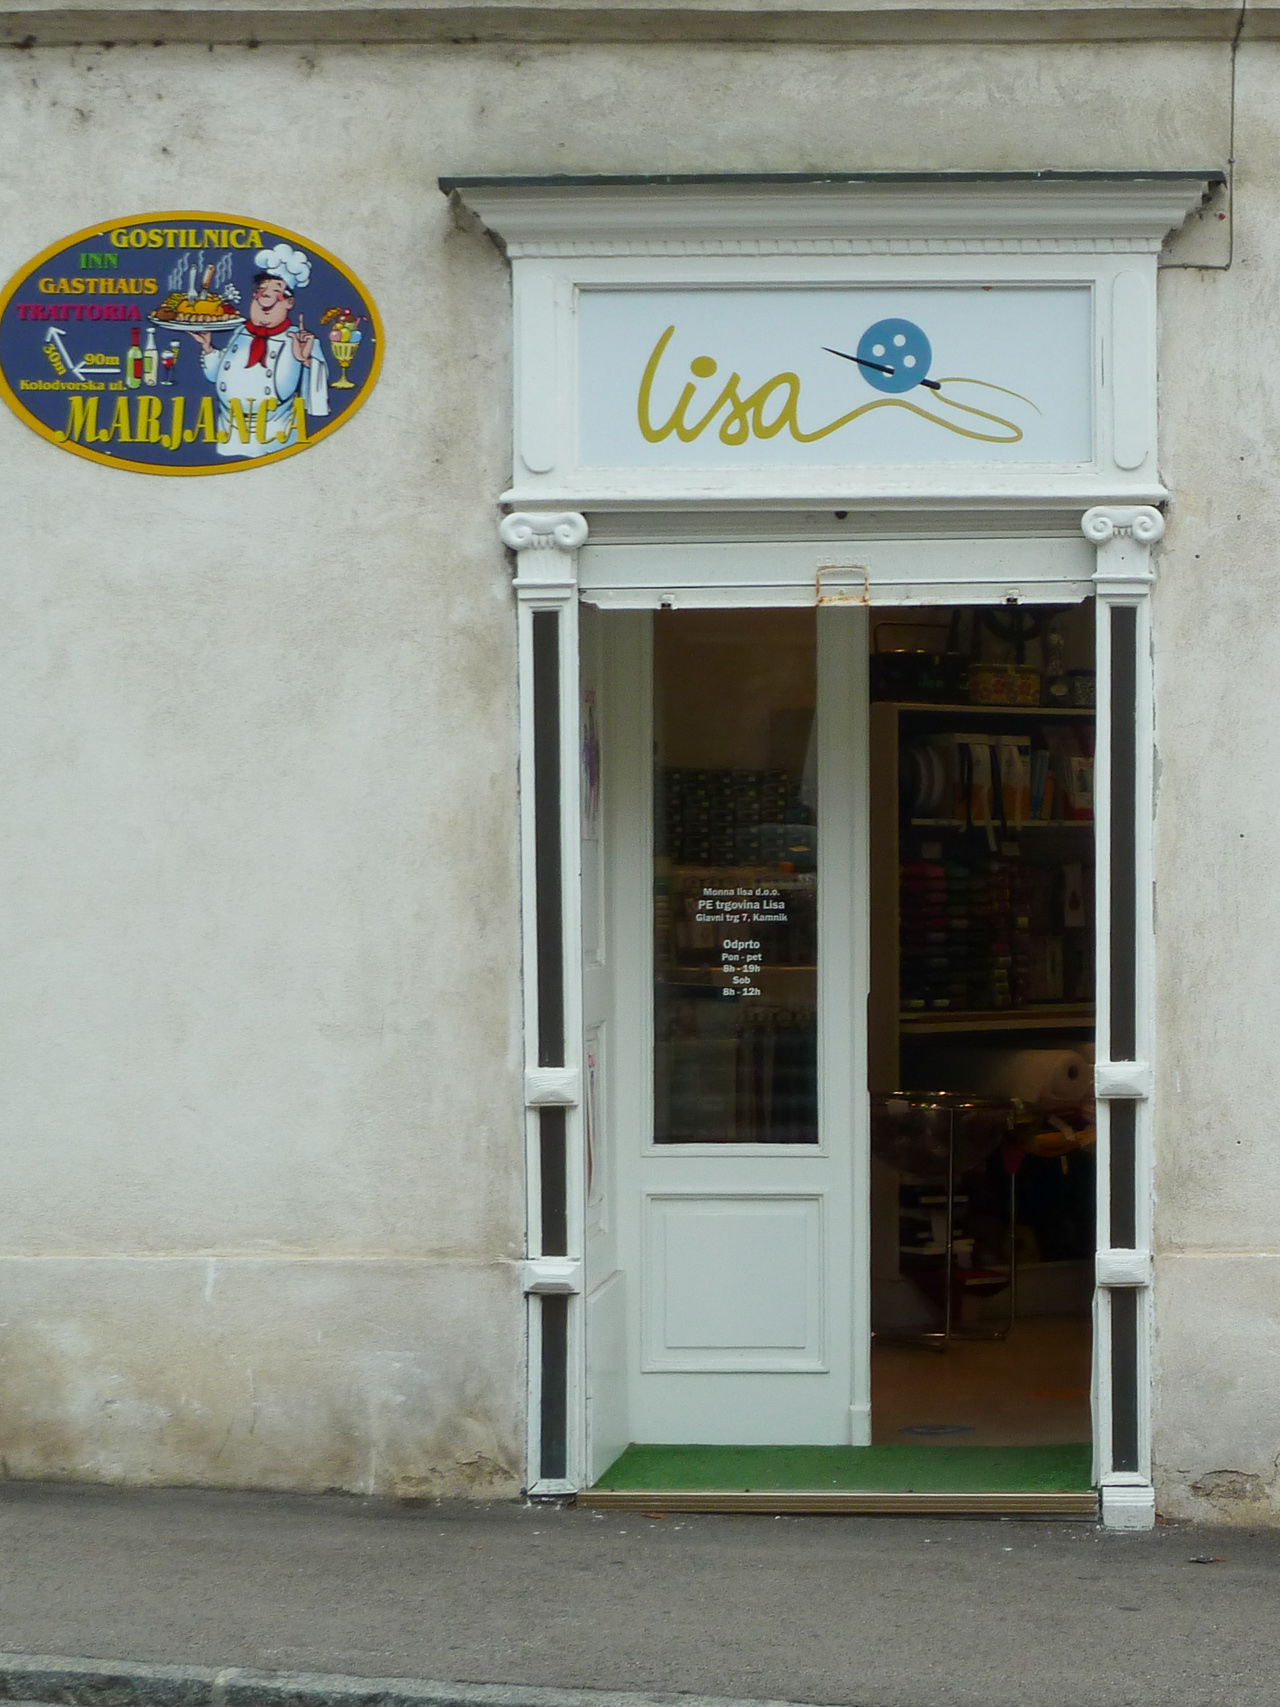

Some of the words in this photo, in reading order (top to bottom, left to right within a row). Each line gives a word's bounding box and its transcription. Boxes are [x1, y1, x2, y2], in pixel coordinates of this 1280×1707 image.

[110, 228, 264, 249] GOSTILNICA
[79, 253, 119, 270] INN
[38, 278, 159, 295] GASTHAUS
[16, 304, 142, 321] TRATTORIA
[84, 353, 120, 365] 90m
[19, 379, 105, 391] Kolodvorska
[109, 380, 127, 391] ul.
[54, 396, 311, 451] MARJANCA
[703, 888, 735, 896] Monna
[755, 888, 780, 896] d.o.o.
[698, 900, 714, 910] PE
[715, 900, 760, 911] trgovina
[763, 900, 785, 910] Lisa
[696, 913, 724, 922] Glavni
[726, 914, 740, 922] trg
[753, 913, 788, 922] Kamnik
[723, 940, 760, 950] Odprto
[721, 953, 739, 961] Pon
[746, 954, 762, 962] pet
[723, 965, 735, 973] 8h
[743, 965, 761, 973] 19h
[732, 976, 751, 985] Sob
[723, 988, 735, 996] 8h
[743, 988, 761, 996] 12h
